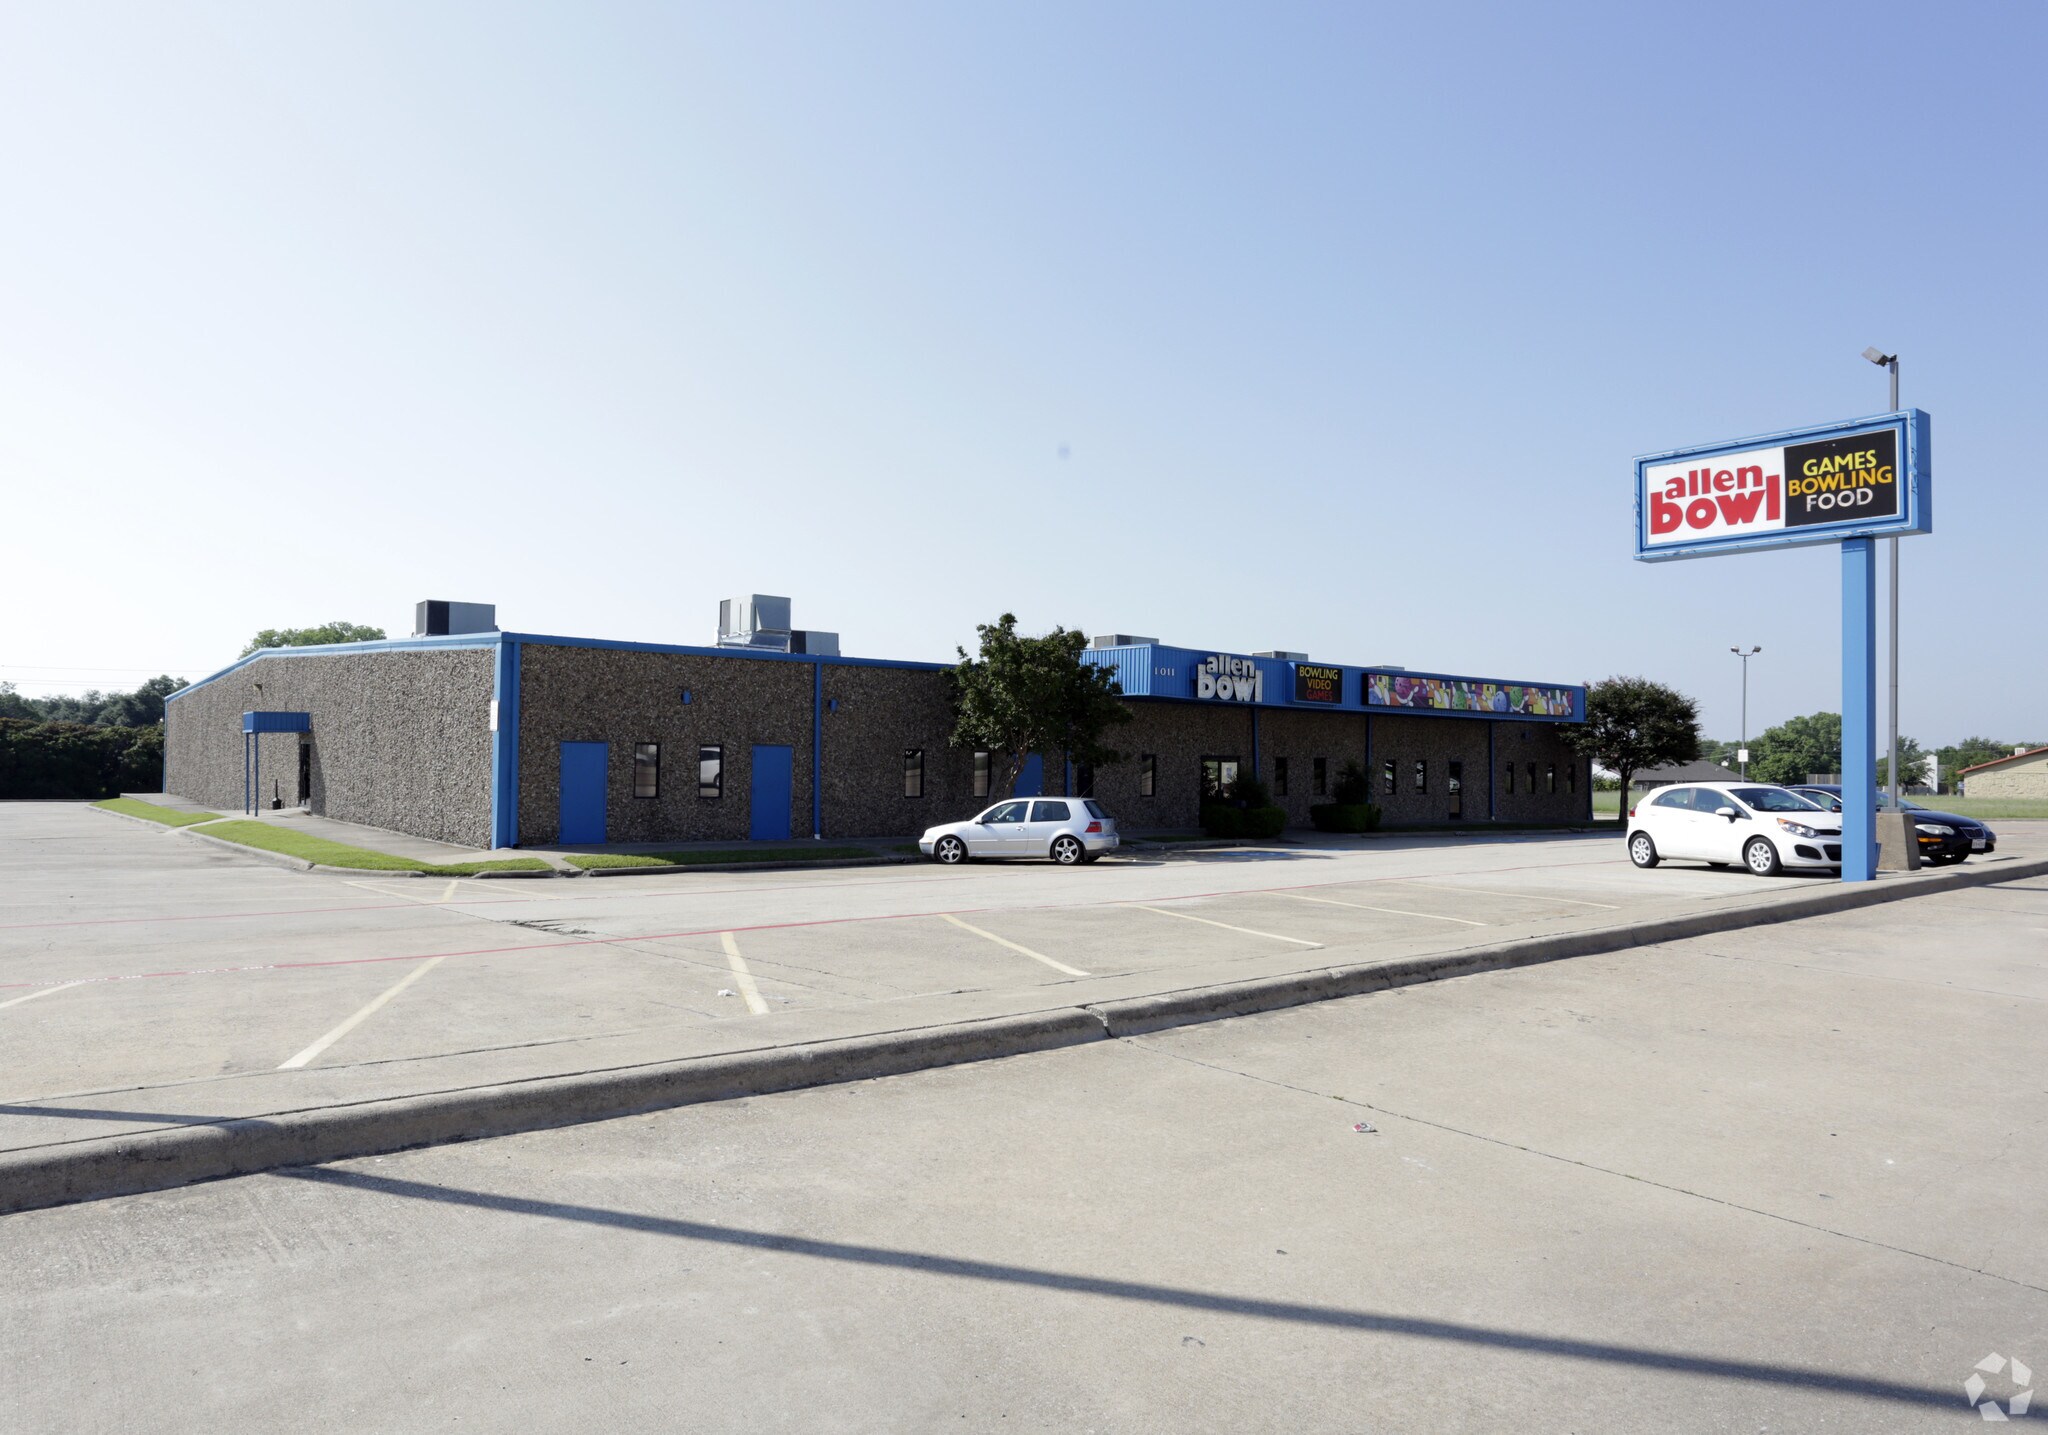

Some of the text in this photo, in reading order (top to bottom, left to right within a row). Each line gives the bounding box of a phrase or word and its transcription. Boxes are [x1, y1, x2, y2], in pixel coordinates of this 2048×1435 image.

[1803, 449, 1877, 476] GAMES
[1665, 465, 1763, 499] allen
[1788, 465, 1892, 497] BOWLING
[1650, 474, 1781, 535] bowl
[1806, 488, 1873, 512] FOOD
[1206, 654, 1255, 678] allen
[1299, 666, 1338, 680] BOWLING
[1197, 663, 1263, 703] bowl
[1306, 689, 1333, 702] GAMES
[1307, 678, 1332, 690] VIDEO
